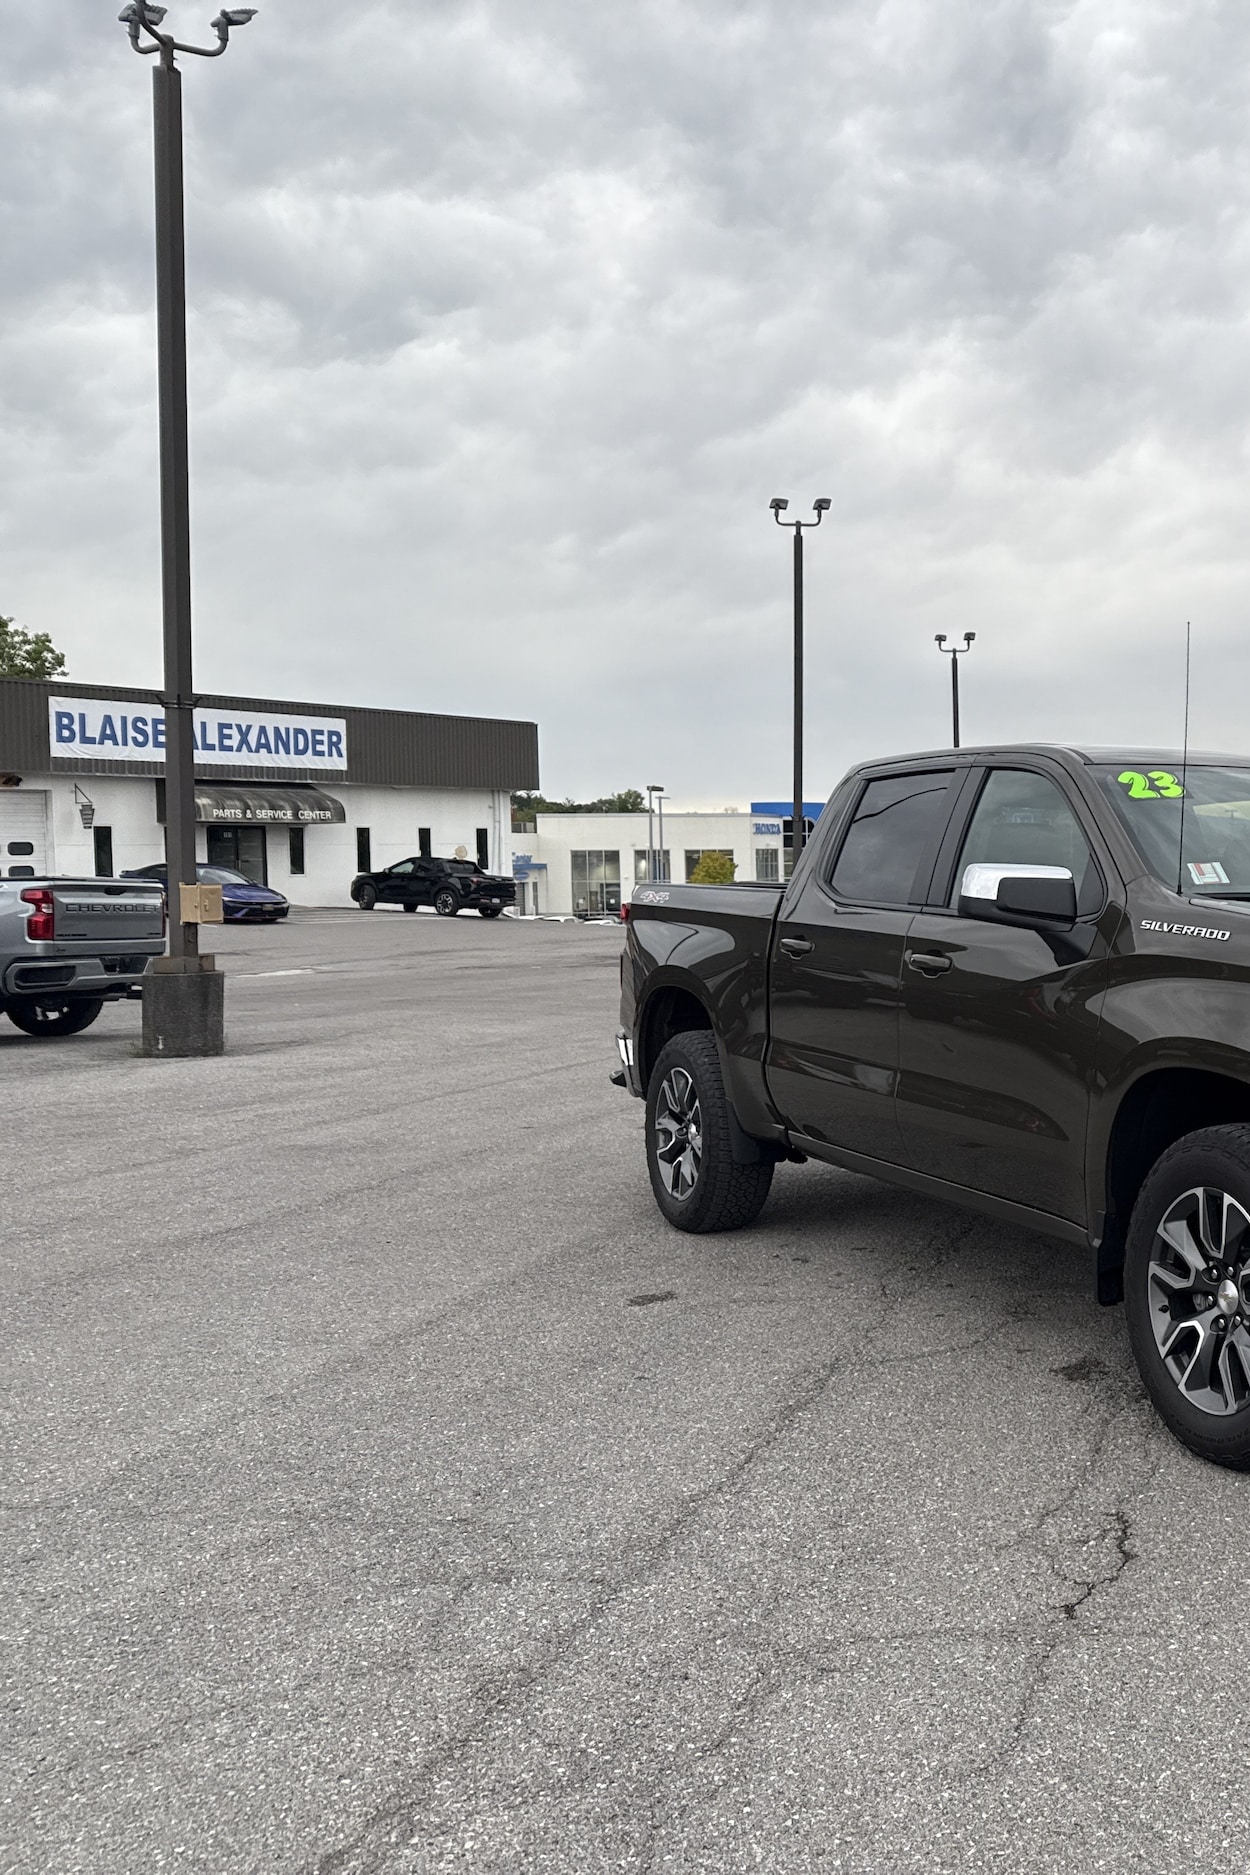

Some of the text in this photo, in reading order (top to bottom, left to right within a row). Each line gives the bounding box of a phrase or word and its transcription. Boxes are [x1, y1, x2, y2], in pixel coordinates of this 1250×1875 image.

[1118, 770, 1186, 799] 23
[213, 809, 331, 820] PARTS & SERVICE CENTER
[753, 822, 781, 836] HONDA
[65, 903, 160, 913] CHEVROLET
[1140, 919, 1231, 942] SILVERADO
